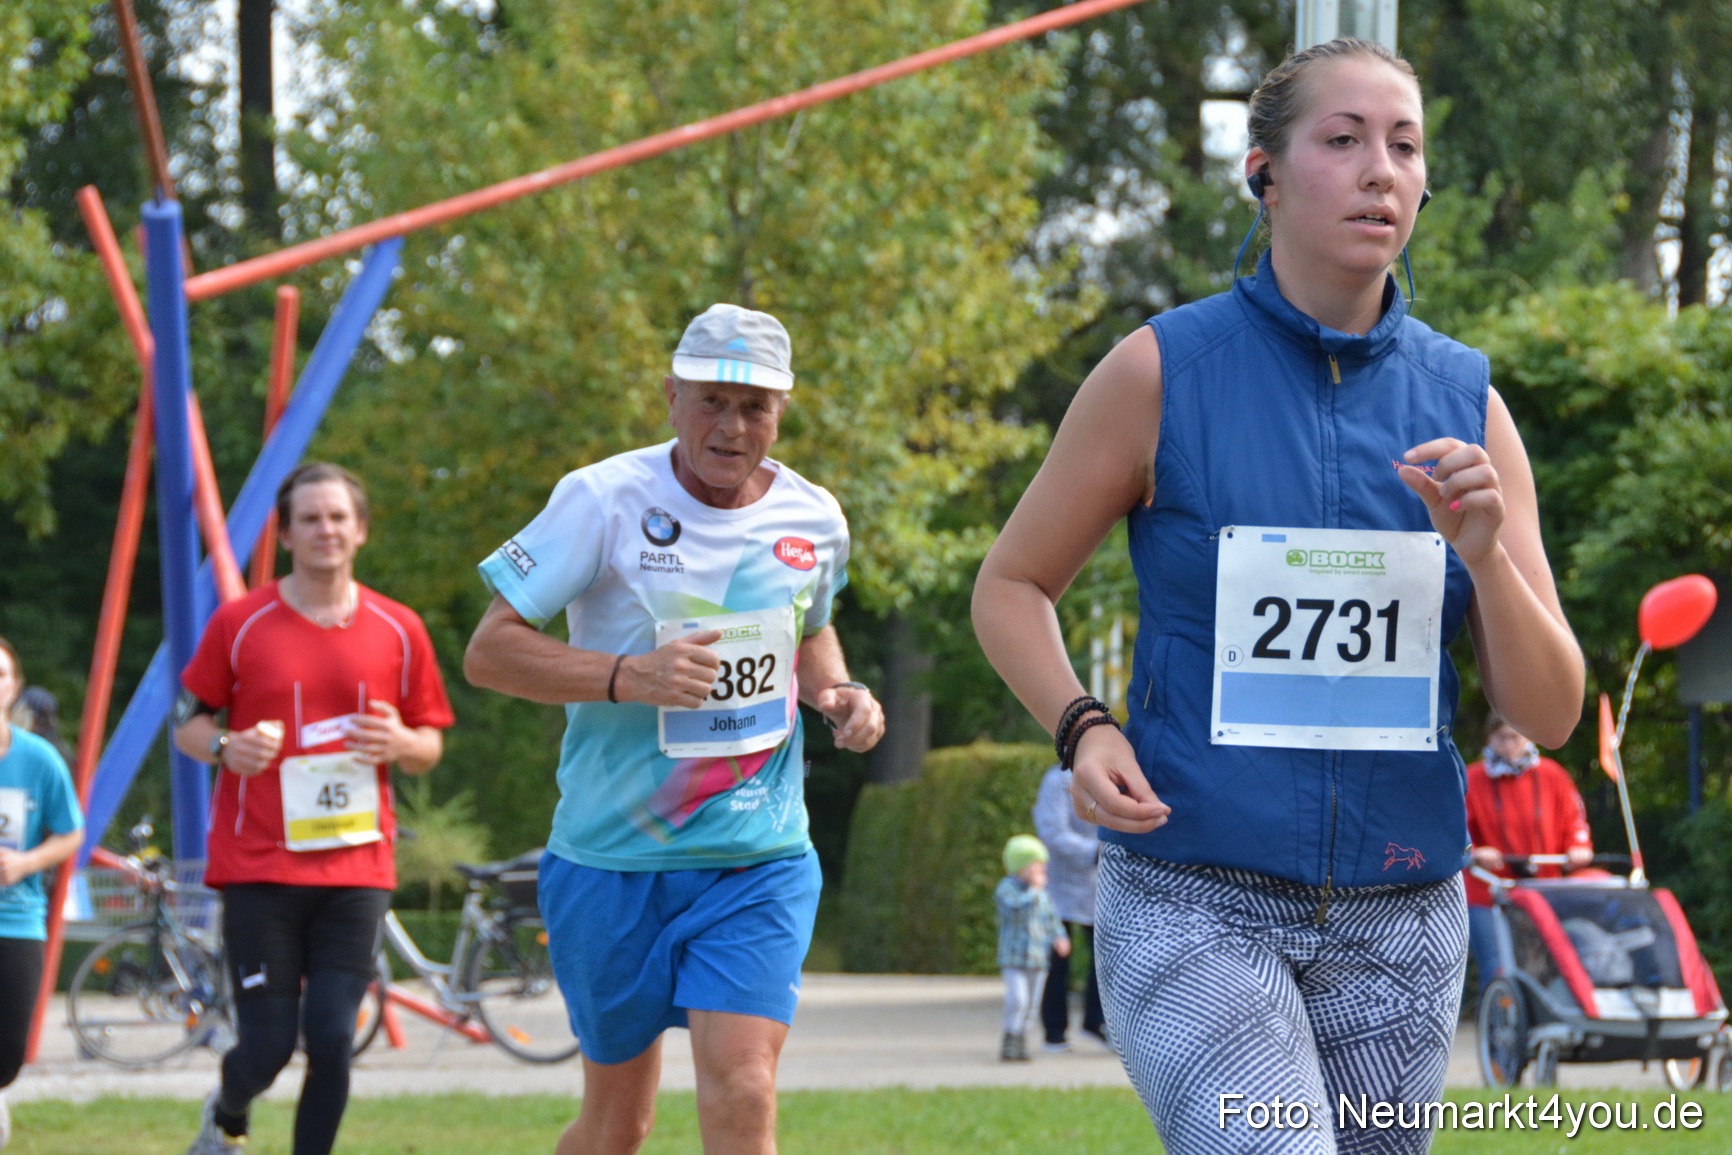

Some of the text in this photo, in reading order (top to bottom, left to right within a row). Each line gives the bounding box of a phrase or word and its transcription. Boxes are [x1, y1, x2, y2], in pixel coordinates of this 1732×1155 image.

[640, 551, 684, 565] PARTL
[1309, 550, 1386, 569] BOCK
[640, 563, 684, 574] Neumarkt
[1251, 596, 1400, 663] 2731
[703, 653, 776, 702] 382
[709, 714, 756, 732] Johann
[316, 783, 348, 811] 45
